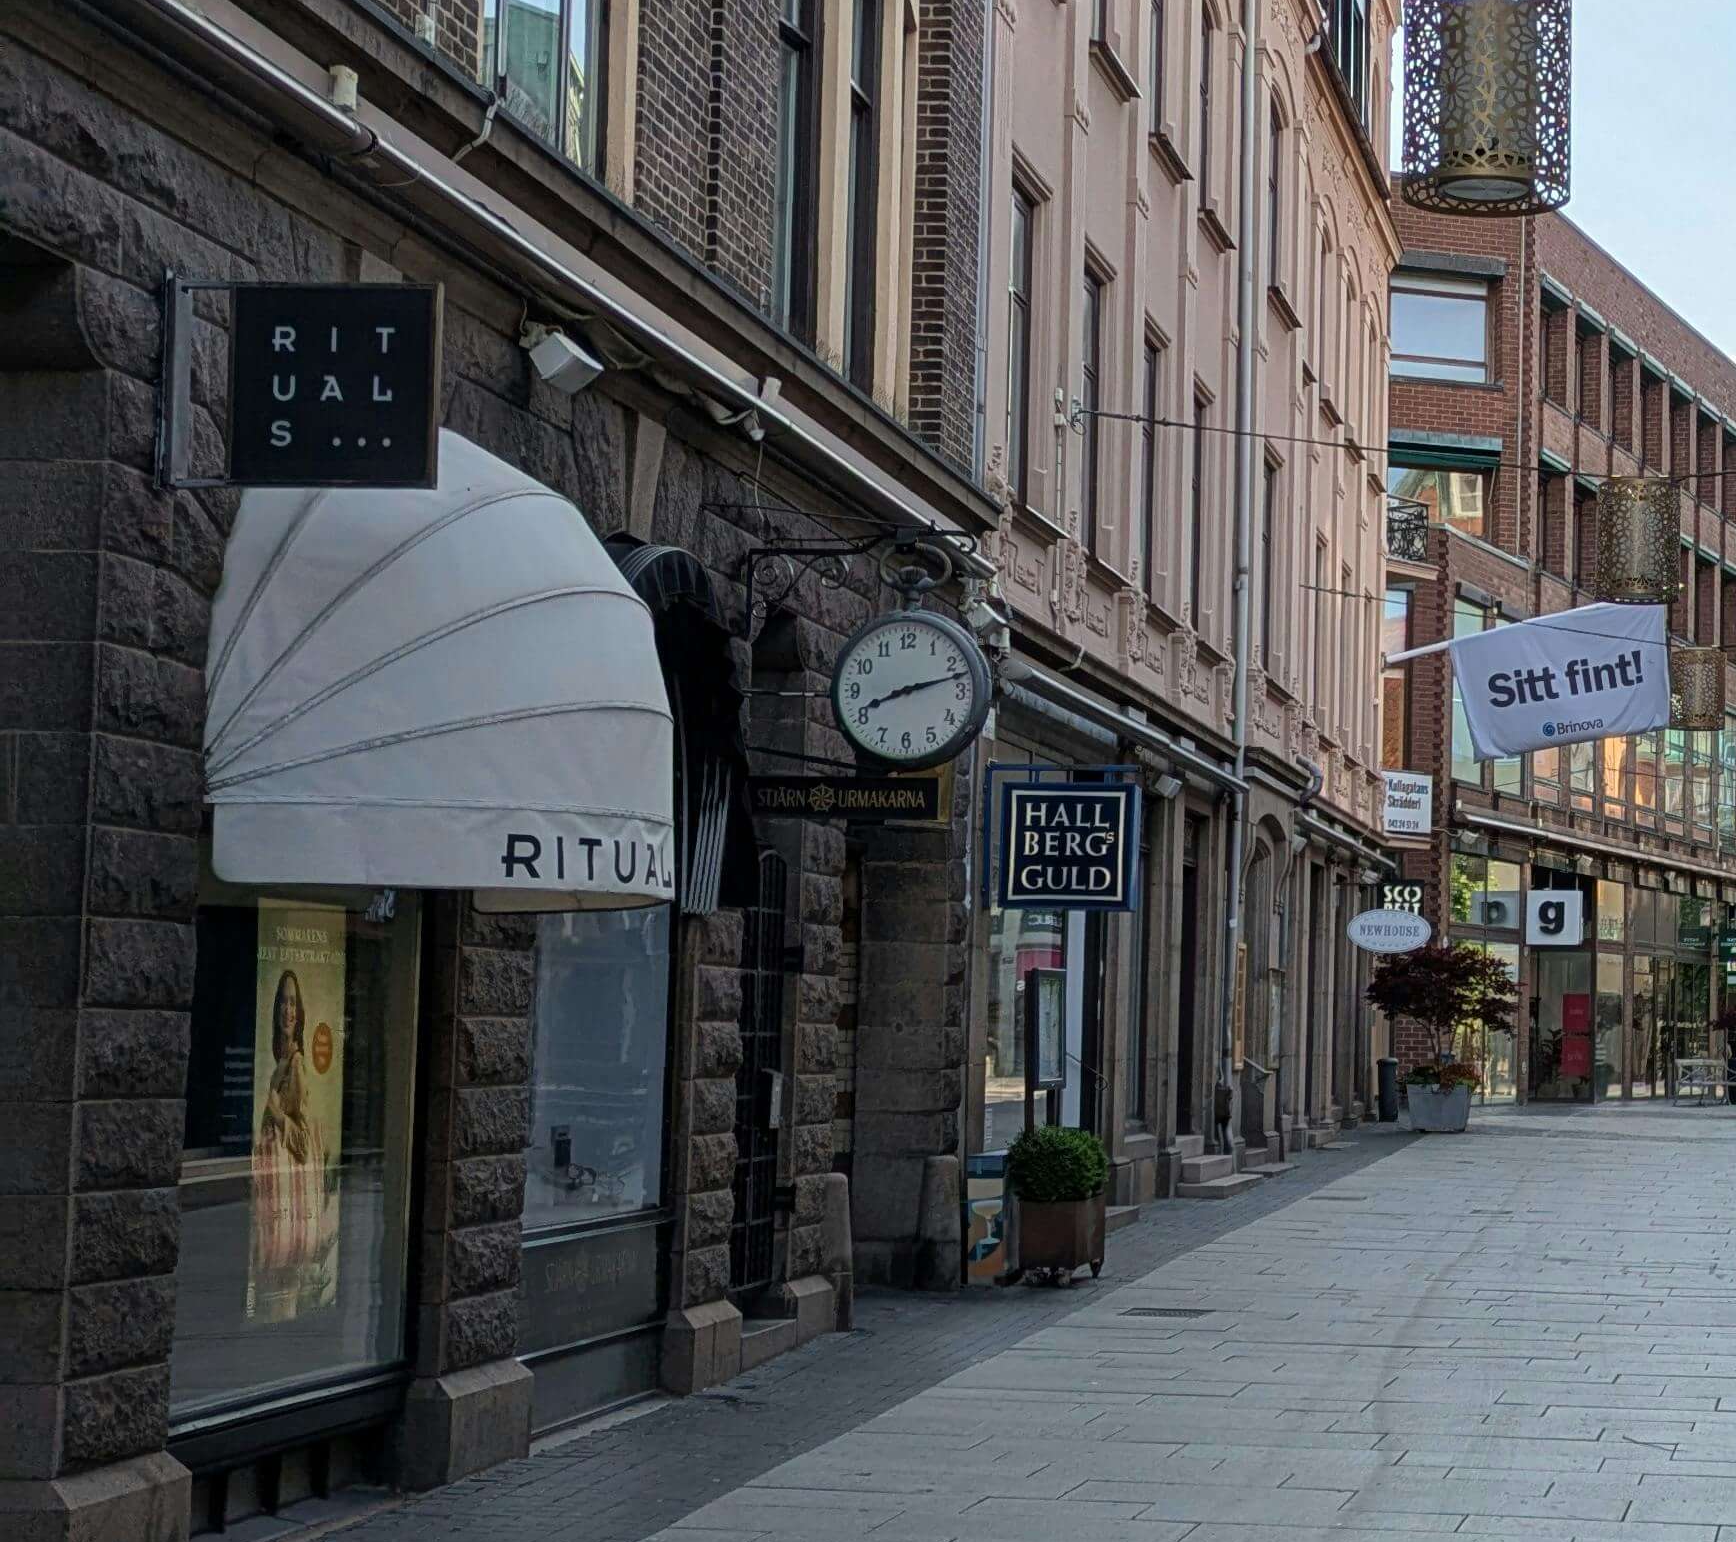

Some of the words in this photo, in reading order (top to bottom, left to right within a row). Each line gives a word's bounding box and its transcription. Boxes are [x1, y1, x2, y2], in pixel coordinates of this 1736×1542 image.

[271, 326, 396, 354] RIT
[272, 375, 393, 402] UAL
[878, 641, 891, 657] 11
[900, 633, 917, 650] 12
[929, 640, 936, 656] 1
[856, 658, 873, 675] 10
[946, 656, 957, 672] 2
[1488, 666, 1560, 708] Sitt
[1564, 650, 1644, 696] fint!
[850, 682, 860, 699] 9
[955, 682, 966, 700] 3
[858, 707, 868, 724] 8
[944, 708, 955, 725] 4
[877, 727, 888, 743] 7
[926, 726, 937, 743] 5
[1557, 718, 1604, 736] Brinova
[901, 731, 911, 749] 6
[838, 789, 926, 808] URMAKARNA
[1024, 802, 1110, 829] HALL
[501, 833, 673, 888] RITUAL
[1021, 864, 1111, 891] GULD
[1383, 885, 1422, 902] SCO
[1538, 900, 1566, 935] g
[1359, 924, 1421, 938] NEWHOUSE
